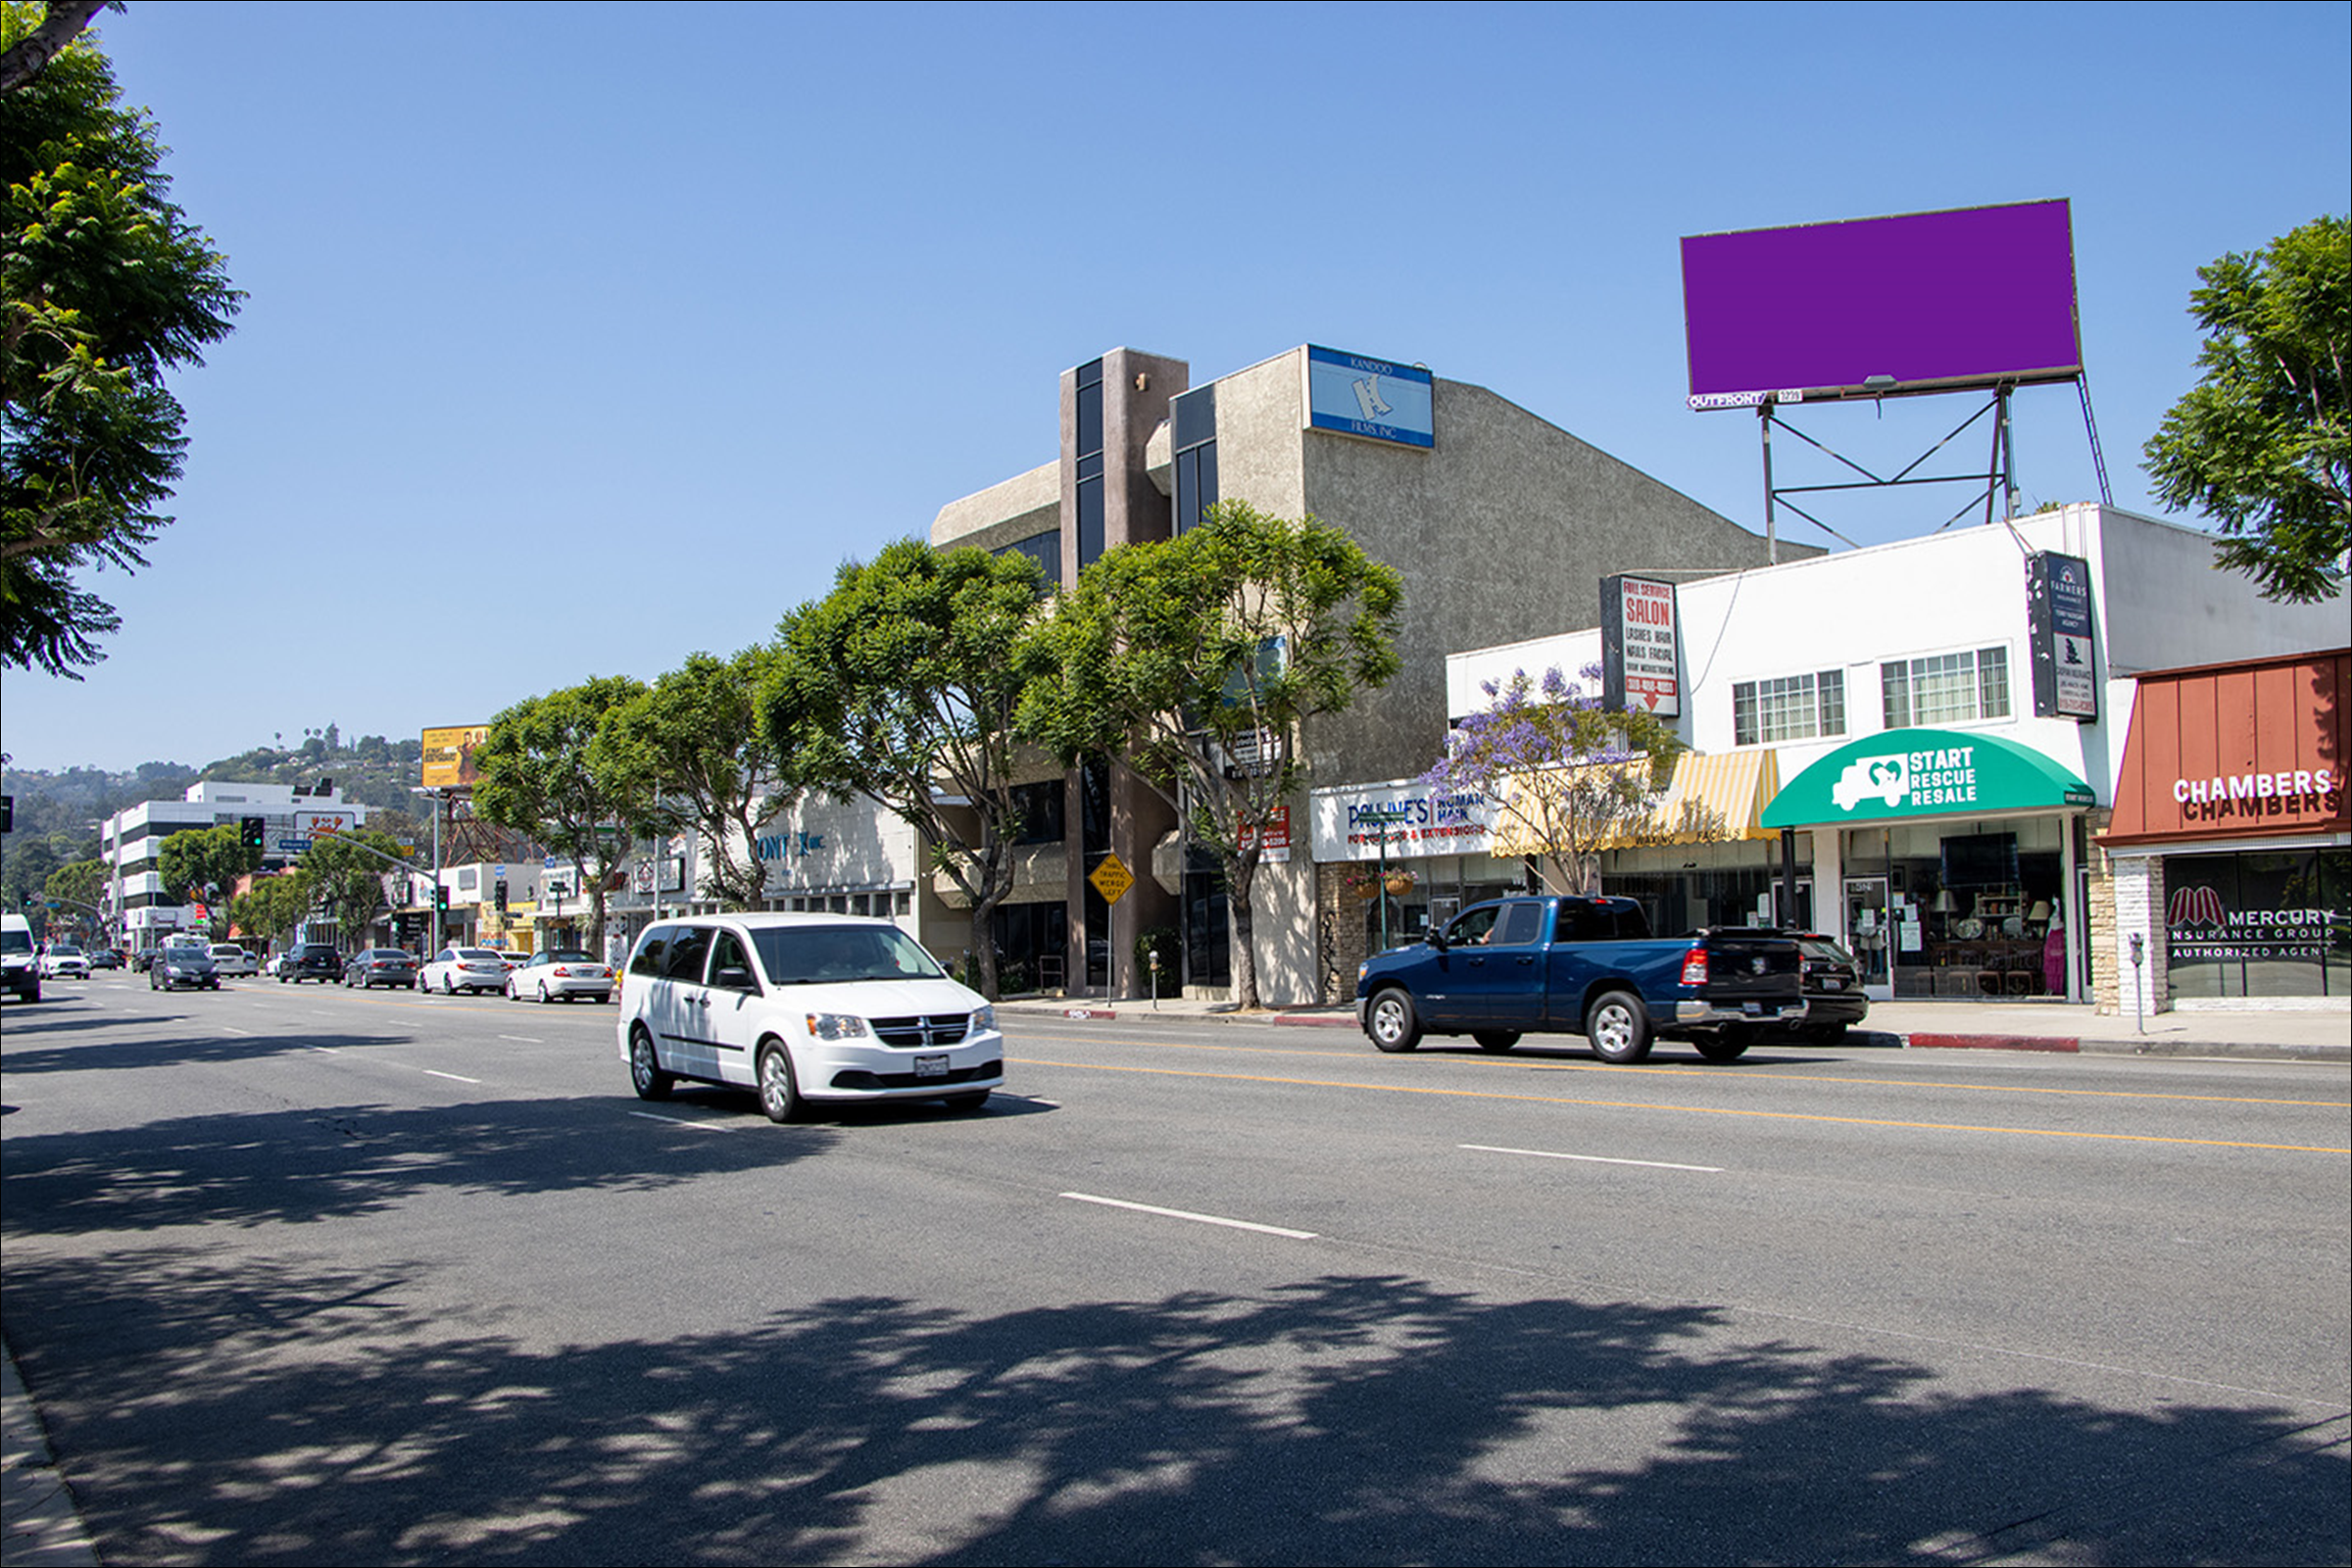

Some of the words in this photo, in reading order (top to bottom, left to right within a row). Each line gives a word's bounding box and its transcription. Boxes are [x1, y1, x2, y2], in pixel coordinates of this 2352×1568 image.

[1350, 358, 1393, 375] KANDOO
[1623, 581, 1639, 595] FULL
[1641, 583, 1670, 600] SERVICE
[2050, 580, 2086, 598] FARMERS
[1627, 598, 1670, 626] SALON
[1626, 627, 1652, 644] LASHES
[1655, 631, 1672, 645] HAIR
[1626, 645, 1646, 660] NAILS
[1909, 747, 1974, 772] START
[1910, 769, 1976, 789] RESCUE
[2174, 768, 2331, 804] CHAMBERS
[1438, 793, 1485, 808] HUMAN
[1912, 785, 1977, 806] RESALE
[1636, 834, 1675, 845] WAXING
[1696, 828, 1740, 840] FACIALS
[1100, 870, 1126, 879] TRAFFIC
[2229, 909, 2334, 926] MERCURY
[2166, 928, 2264, 940] INSURANCE
[2274, 928, 2334, 939] GROUP
[2173, 947, 2271, 957] AUTHORIZED
[2278, 947, 2329, 956] AGENT
